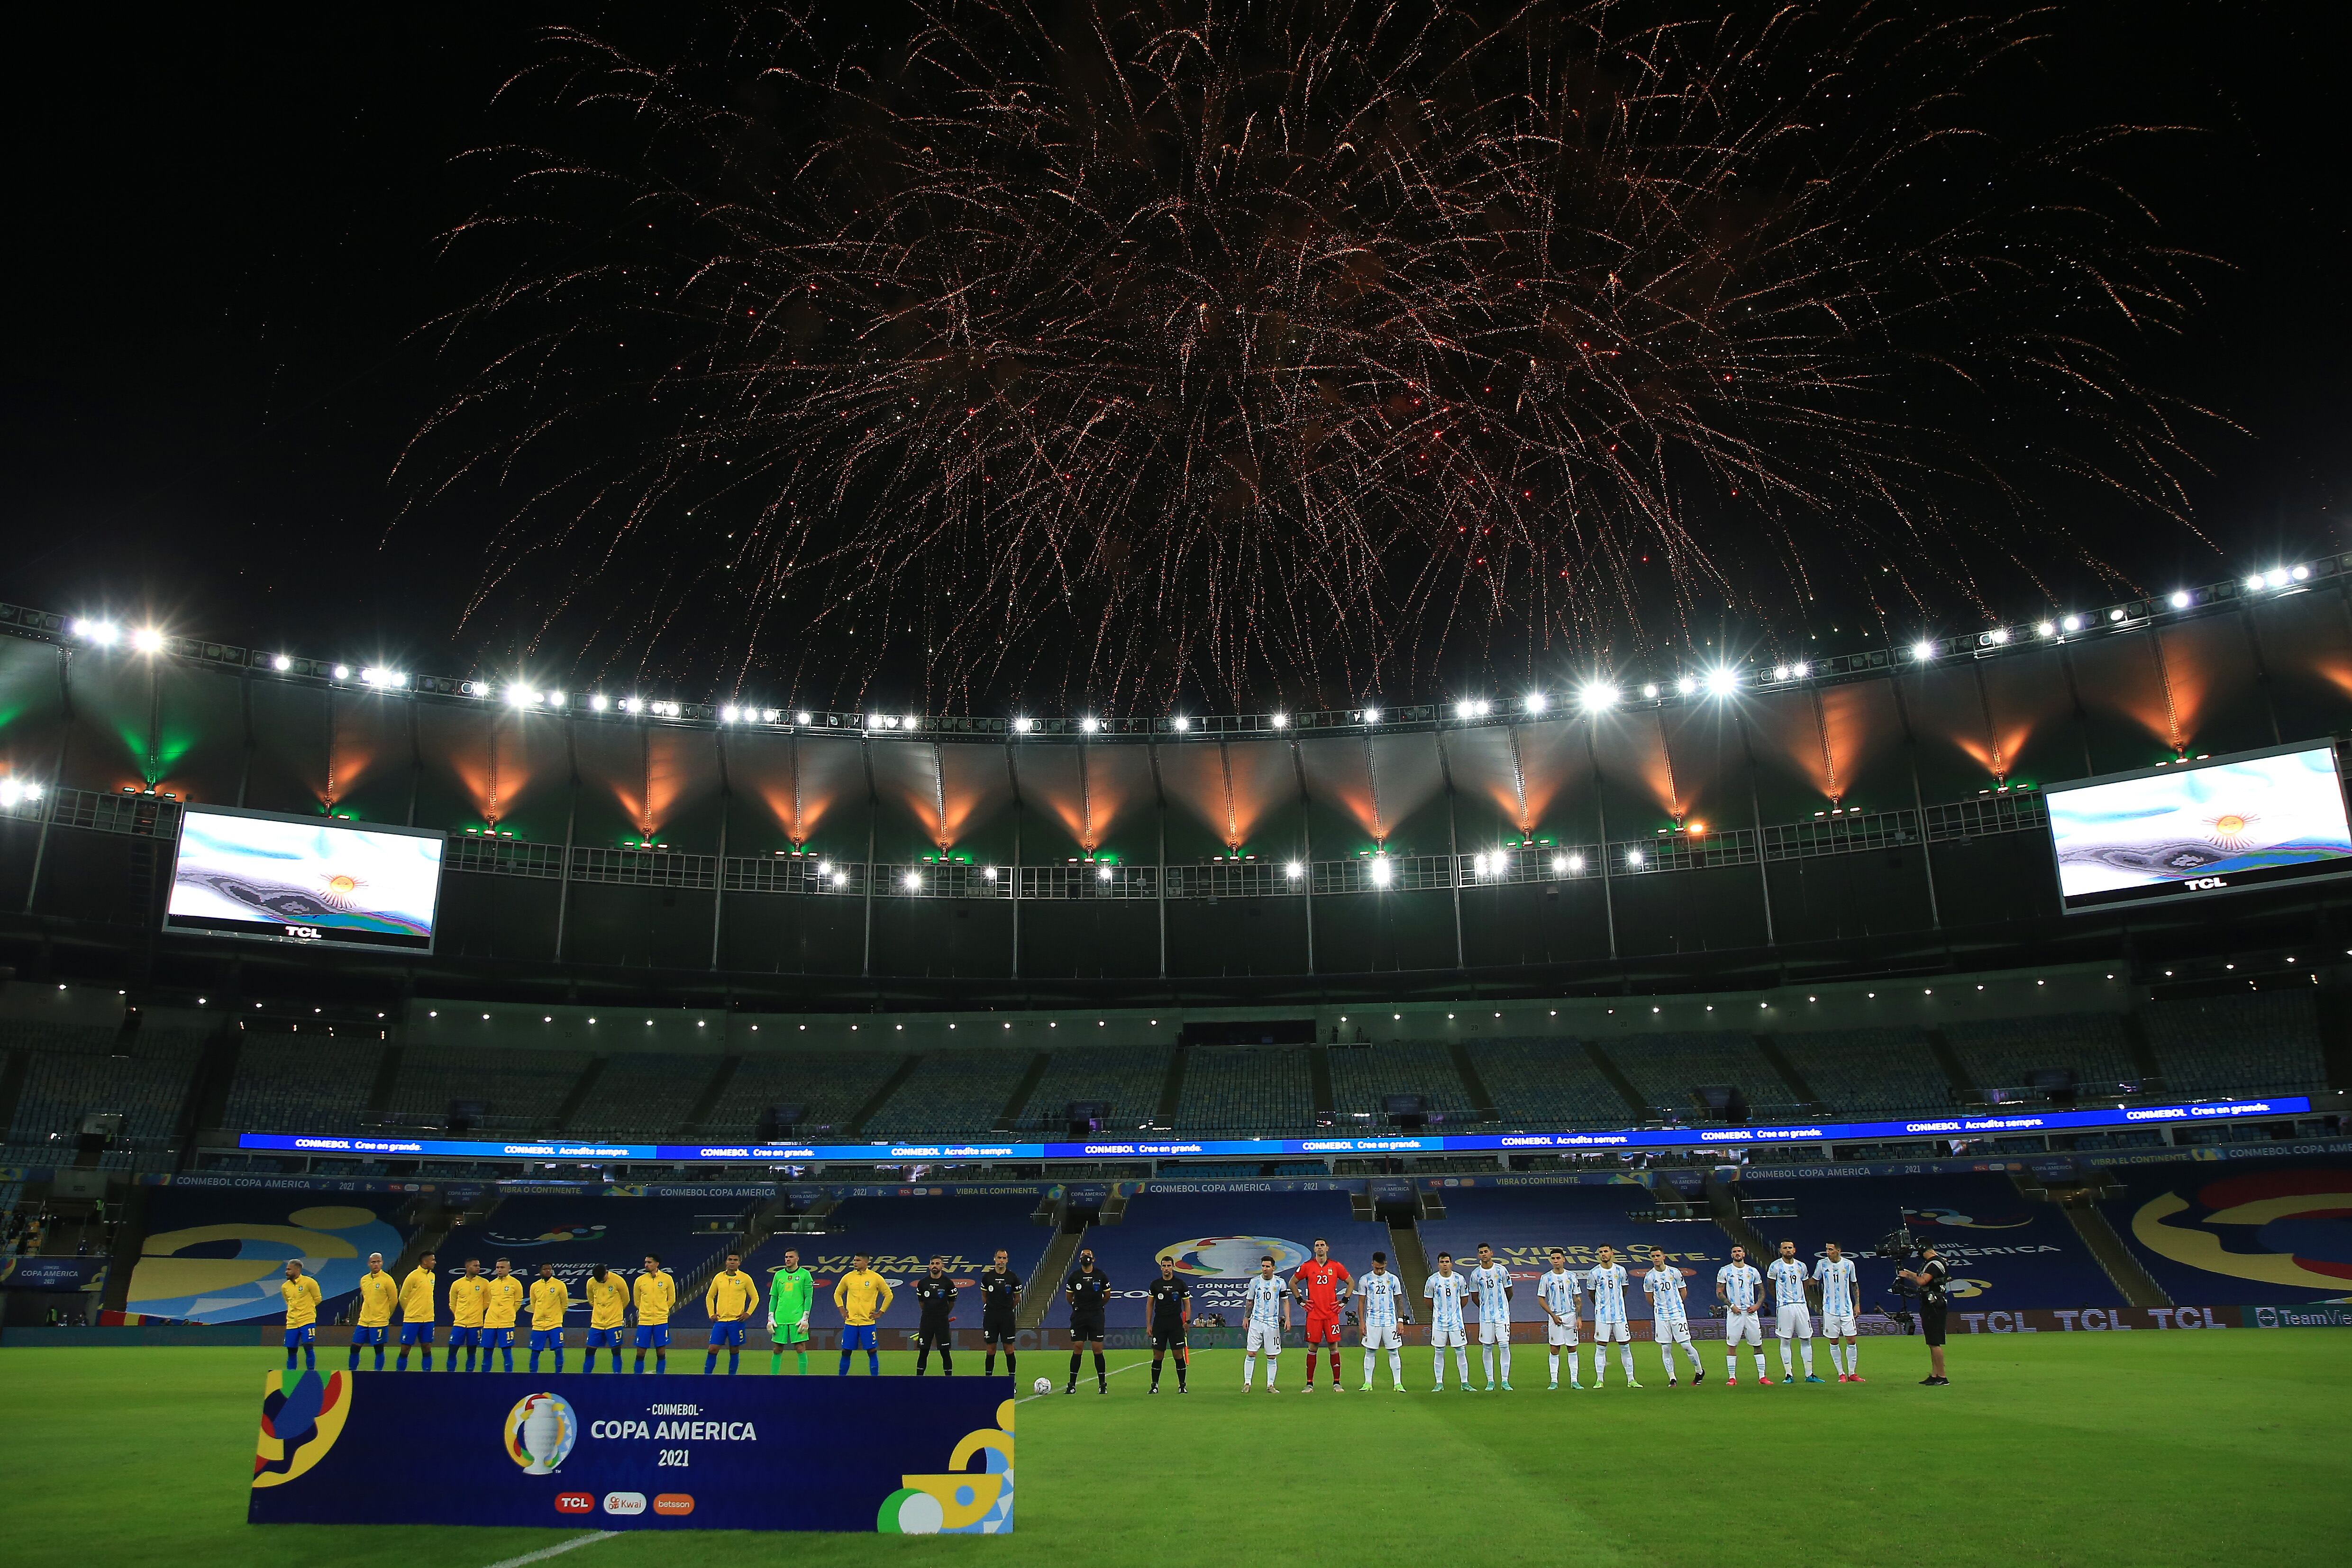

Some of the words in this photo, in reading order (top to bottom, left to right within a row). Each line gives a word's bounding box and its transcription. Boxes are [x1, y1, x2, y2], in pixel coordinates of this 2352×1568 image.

[2185, 877, 2226, 890] TCL
[285, 926, 322, 939] TCL
[2126, 1108, 2188, 1120] CONMEBOL
[2191, 1106, 2215, 1115] Cree
[1906, 1122, 1961, 1132] CONMEBOL
[1965, 1119, 2005, 1129] Acredite
[1701, 1131, 1753, 1140] CONMEBOL
[1757, 1130, 1777, 1138] Cree
[295, 1139, 351, 1149] CONMEBOL
[355, 1141, 376, 1149] Cree
[1501, 1137, 1553, 1146] CONMEBOL
[1556, 1135, 1593, 1144] Acredite
[504, 1145, 556, 1154] CONMEBOL
[559, 1147, 595, 1155] Acredite
[1085, 1145, 1135, 1154] CONMEBOL
[1139, 1145, 1158, 1153] Cree
[1302, 1141, 1354, 1150] CONMEBOL
[1357, 1141, 1377, 1149] Cree
[700, 1148, 749, 1157] CONMEBOL
[753, 1149, 772, 1157] Cree
[891, 1148, 940, 1156] CONMEBOL
[944, 1147, 979, 1155] Acredite
[2229, 1147, 2290, 1158] CONMEBOL
[2293, 1145, 2325, 1154] COPA
[2091, 1158, 2117, 1166] VIBRA
[2130, 1153, 2190, 1164] CONTINENTE.
[1746, 1169, 1796, 1179] CONMEBOL
[1799, 1169, 1824, 1177] COPA
[1827, 1167, 1871, 1176] AMERICA
[1905, 1165, 1921, 1173] 2021
[177, 1177, 231, 1186] CONMEBOL
[235, 1178, 262, 1187] COPA
[265, 1180, 310, 1188] AMERICA
[339, 1182, 355, 1190] 2021
[1529, 1176, 1580, 1185] CONTINENTE.
[531, 1187, 583, 1195] CONTINENTE.
[660, 1188, 707, 1196] CONMEBOL
[710, 1188, 733, 1196] COPA
[736, 1188, 776, 1196] AMERICA
[1150, 1184, 1200, 1193] CONMEBOL
[1229, 1183, 1271, 1191] AMERICA
[1303, 1182, 1318, 1190] 2021
[448, 1268, 528, 1276] COA
[766, 1265, 996, 1273] CONINENTE
[1316, 1275, 1328, 1284] 23
[1738, 1279, 1743, 1287] 7
[1789, 1275, 1796, 1284] 19
[1832, 1274, 1839, 1283] 11
[1486, 1280, 1494, 1288] 13
[1659, 1282, 1671, 1291] 20
[1376, 1285, 1386, 1294] 22
[1446, 1288, 1451, 1297] 8
[1559, 1285, 1564, 1294] 4
[1263, 1291, 1271, 1301] 10
[1960, 1311, 2037, 1334] TCL
[2053, 1309, 2132, 1332] TCL
[2148, 1307, 2226, 1330] TCL
[1331, 1324, 1340, 1335] 23
[1678, 1323, 1689, 1332] 20
[377, 1329, 383, 1338] 7
[506, 1331, 514, 1340] 19
[615, 1330, 622, 1340] 17
[739, 1330, 743, 1339] 5
[872, 1332, 876, 1341] 3
[1460, 1328, 1465, 1337] 8
[1015, 1329, 1059, 1350] CL
[1273, 1337, 1280, 1345] 10
[591, 1420, 650, 1439] COPA
[655, 1421, 757, 1441] AMERICA
[658, 1449, 689, 1467] 2021
[561, 1497, 588, 1507] TCL
[621, 1500, 642, 1509] Kwai
